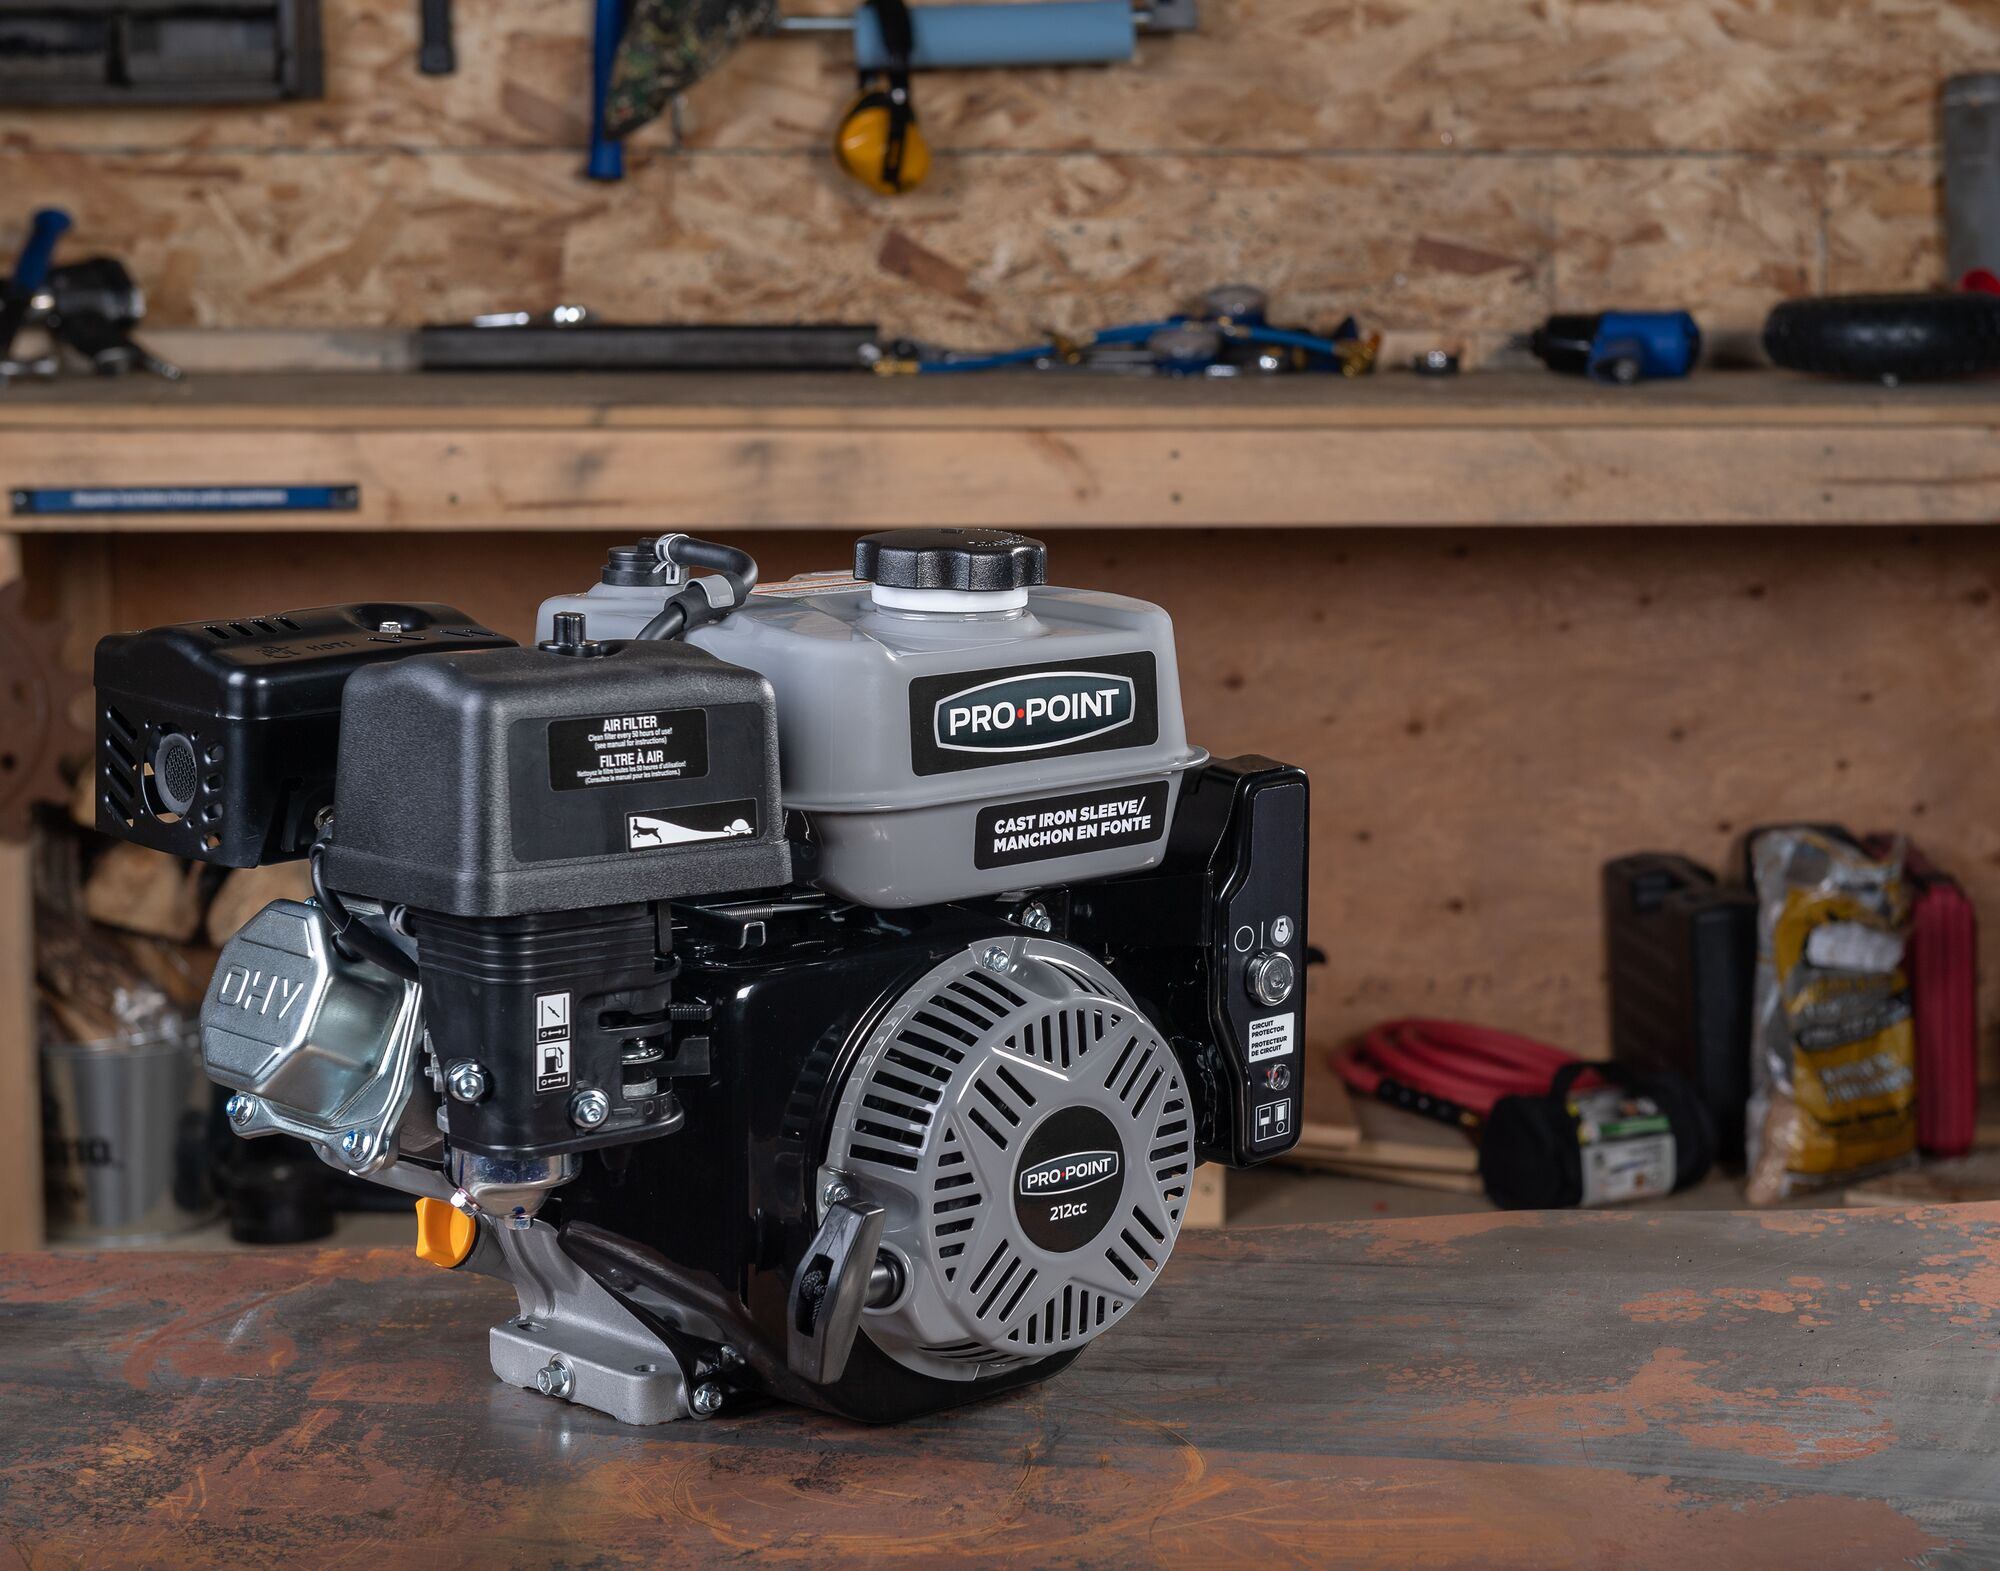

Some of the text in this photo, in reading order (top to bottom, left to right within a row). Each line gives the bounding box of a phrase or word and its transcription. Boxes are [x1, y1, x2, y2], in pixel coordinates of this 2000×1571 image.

[603, 715, 658, 732] AIR FILTER
[588, 734, 603, 742] Clean
[617, 732, 631, 740] every
[631, 730, 639, 738] 50
[655, 728, 661, 736] of
[594, 742, 607, 751] (see
[607, 740, 626, 748] manual
[635, 736, 668, 746] instructions)
[600, 749, 664, 768] FILTRE À AIR
[994, 797, 1146, 834] CAST IRON SLEEVE/
[993, 815, 1151, 854] MANCHON EN FONTE
[1251, 1020, 1274, 1031] CIRCUIT
[1251, 1025, 1285, 1038] PROTECTOR
[1251, 1035, 1288, 1049] PROTECTEUR
[1251, 1044, 1282, 1057] DE CIRCUIT
[1049, 1203, 1088, 1222] 212cc
